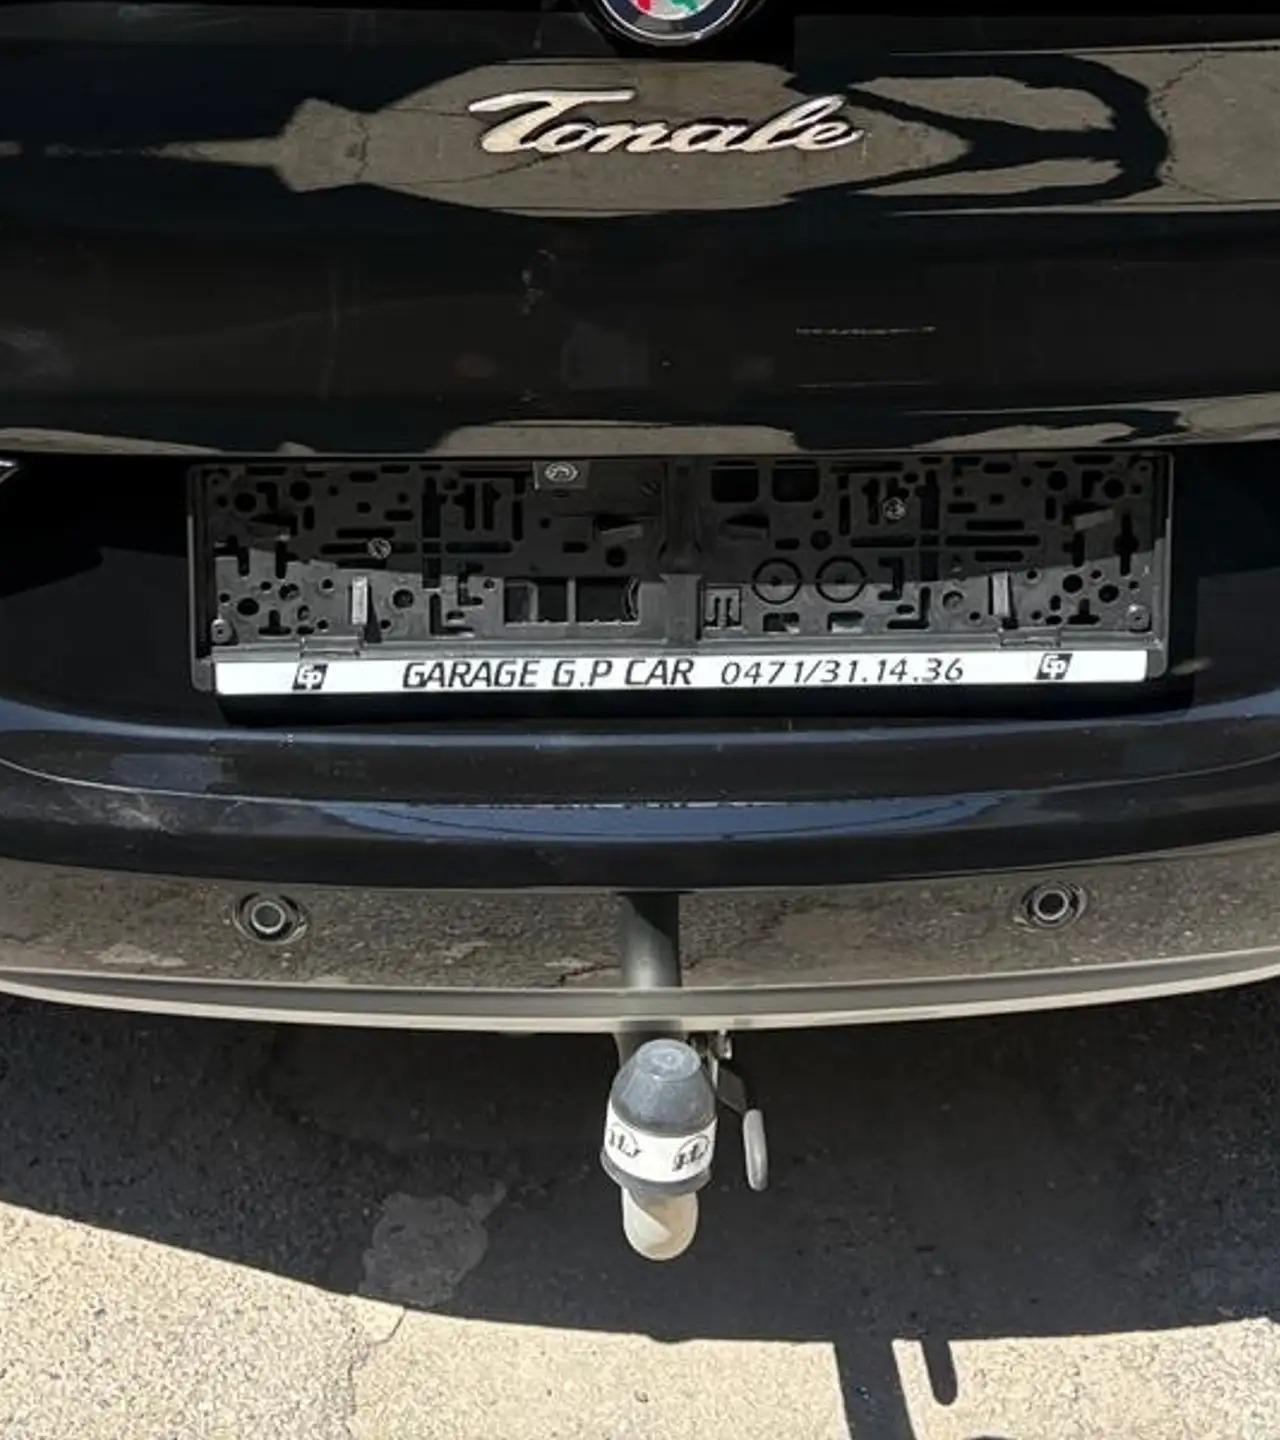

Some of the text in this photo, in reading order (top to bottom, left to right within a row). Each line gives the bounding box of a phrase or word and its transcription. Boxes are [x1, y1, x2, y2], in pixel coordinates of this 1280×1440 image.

[468, 89, 865, 153] Tonale
[402, 660, 539, 690] GARAGE
[551, 659, 614, 688] G.P
[625, 658, 694, 686] CAR
[720, 657, 965, 685] 0471/31.14.36
